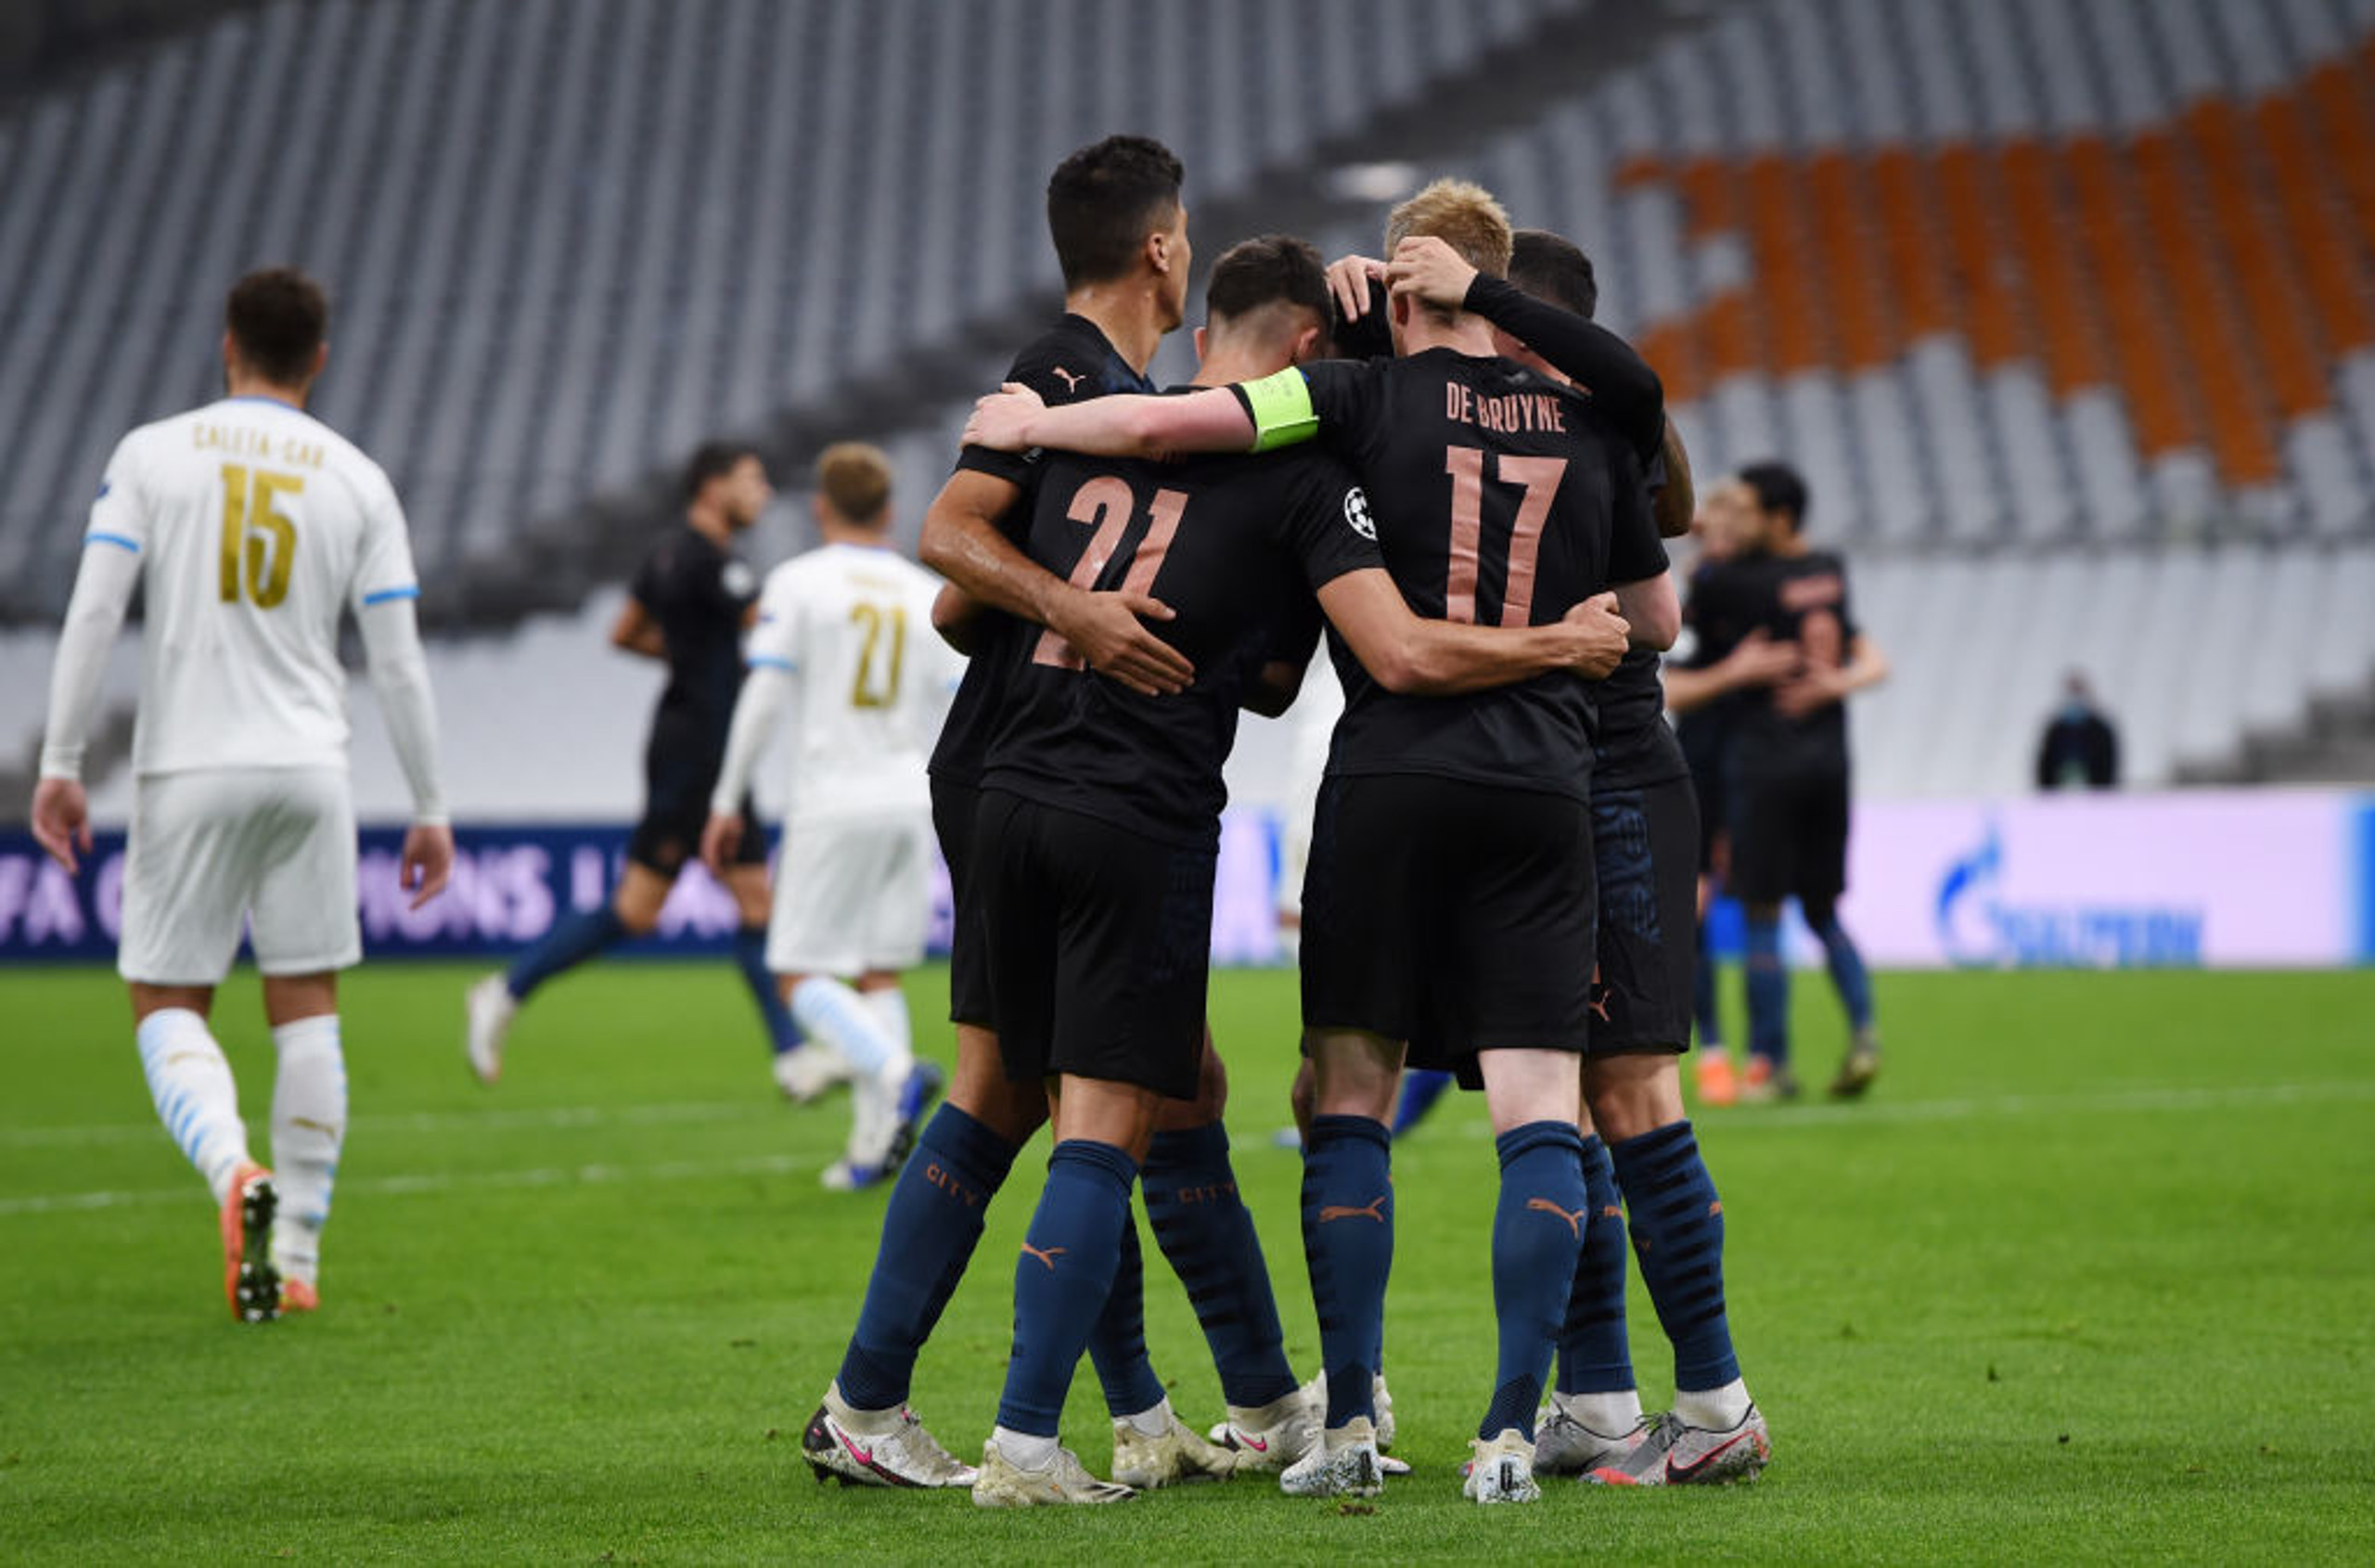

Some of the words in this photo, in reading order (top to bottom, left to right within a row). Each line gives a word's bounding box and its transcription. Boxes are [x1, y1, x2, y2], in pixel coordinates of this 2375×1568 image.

[1445, 381, 1473, 423] DE
[1476, 392, 1566, 433] BRUYNE
[219, 463, 305, 610] 15
[1032, 476, 1188, 672] 21
[1445, 444, 1568, 628] 17
[851, 602, 906, 709] 21
[927, 1163, 980, 1206] CITY
[1178, 1182, 1236, 1206] CITY
